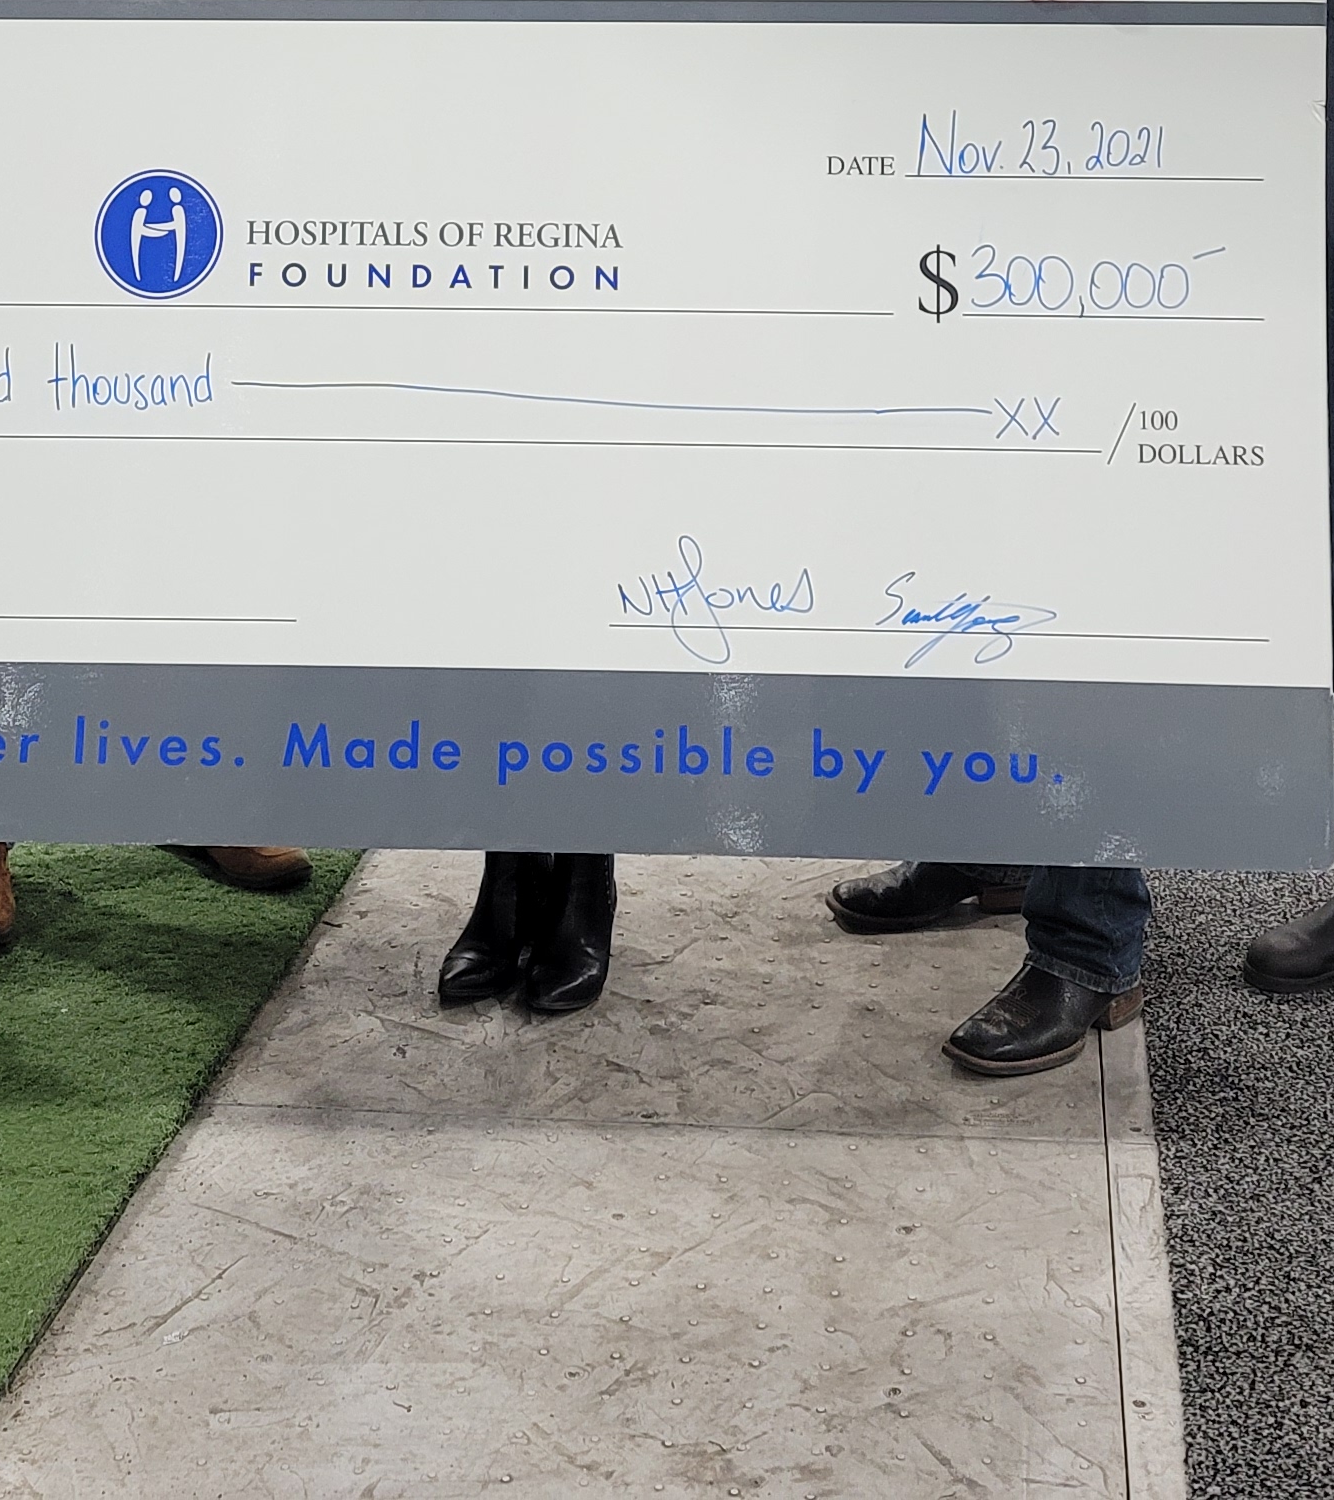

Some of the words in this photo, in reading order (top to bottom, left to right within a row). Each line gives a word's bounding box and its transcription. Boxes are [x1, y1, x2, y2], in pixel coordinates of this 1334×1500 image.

[915, 110, 1005, 177] Nov.
[1019, 118, 1074, 176] 23,
[1085, 121, 1164, 171] 2021
[826, 155, 896, 177] DATE
[246, 220, 428, 248] HOSPITALS
[438, 221, 485, 249] OF
[493, 222, 624, 250] REGINA
[249, 262, 620, 292] FOUNDATION
[47, 341, 213, 411] thousand
[993, 397, 1062, 440] XX
[1137, 443, 1265, 468] DOLLARS
[75, 716, 245, 768] lives.
[282, 720, 462, 772] Made
[497, 725, 776, 786] possible
[813, 728, 886, 794] by
[922, 749, 1065, 796] you.
